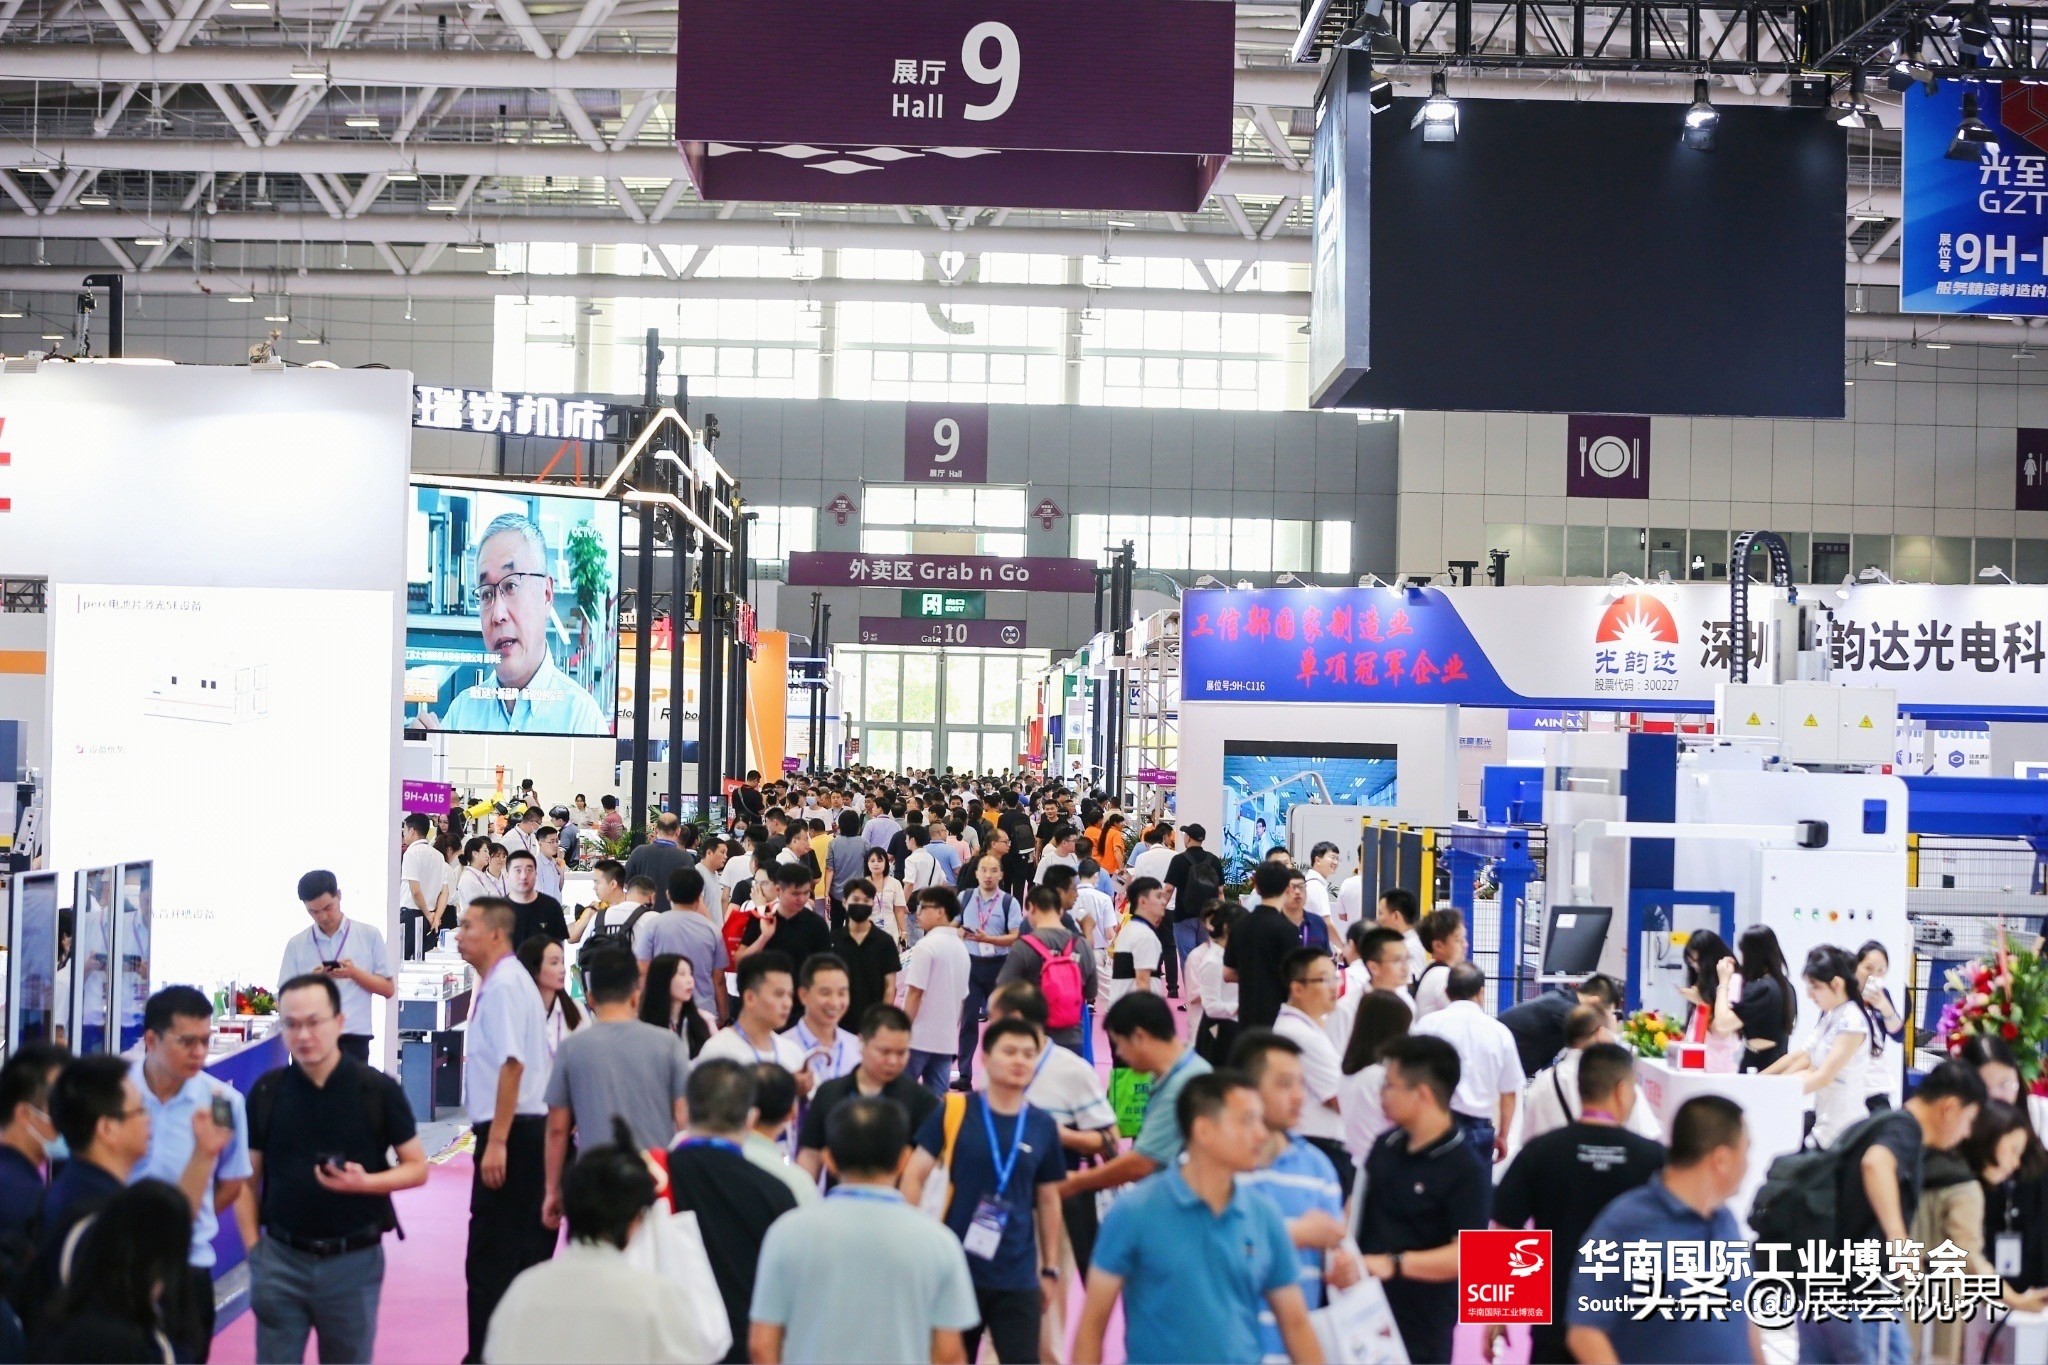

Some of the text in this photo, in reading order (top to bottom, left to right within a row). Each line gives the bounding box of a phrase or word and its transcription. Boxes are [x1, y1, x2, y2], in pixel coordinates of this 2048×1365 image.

[892, 59, 946, 85] 展厅
[961, 21, 1020, 121] 9
[892, 94, 943, 118] Hall
[1938, 233, 1952, 273] 展位号
[933, 417, 960, 463] 9
[948, 469, 963, 478] Hall
[849, 558, 1030, 582] 外卖区 Grab n Go
[862, 630, 869, 641] 9
[944, 623, 968, 644] 10
[1297, 646, 1469, 688] 单项冠军企业
[1595, 648, 1679, 675] 光韵达
[403, 791, 445, 803] 9H-A115
